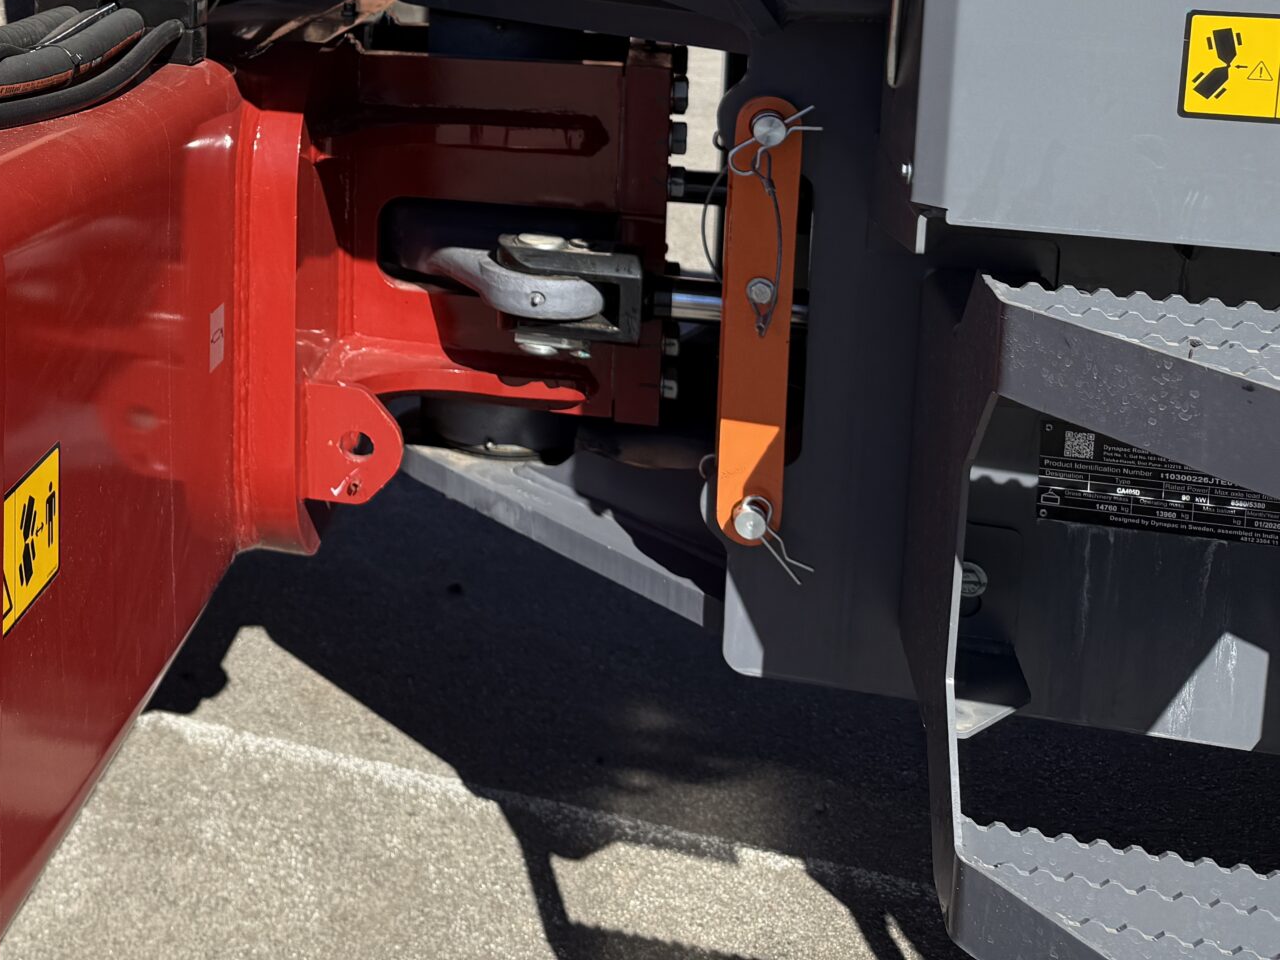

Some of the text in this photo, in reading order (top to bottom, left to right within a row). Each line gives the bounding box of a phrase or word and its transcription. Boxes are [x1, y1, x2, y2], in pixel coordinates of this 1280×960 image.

[1103, 444, 1131, 452] Dynapac
[1044, 459, 1153, 476] Product Identification Number
[1045, 469, 1084, 479] Designation
[1165, 483, 1208, 494] Rated Power
[1083, 491, 1112, 501] machinery
[1096, 503, 1117, 512] 14760
[1140, 498, 1168, 508] Operating
[1109, 515, 1140, 524] Designed
[1141, 518, 1150, 526] by
[1151, 519, 1179, 529] Dynapac
[1188, 524, 1215, 533] Sweden,
[1217, 527, 1253, 537] assembled
[1262, 532, 1279, 540] India
